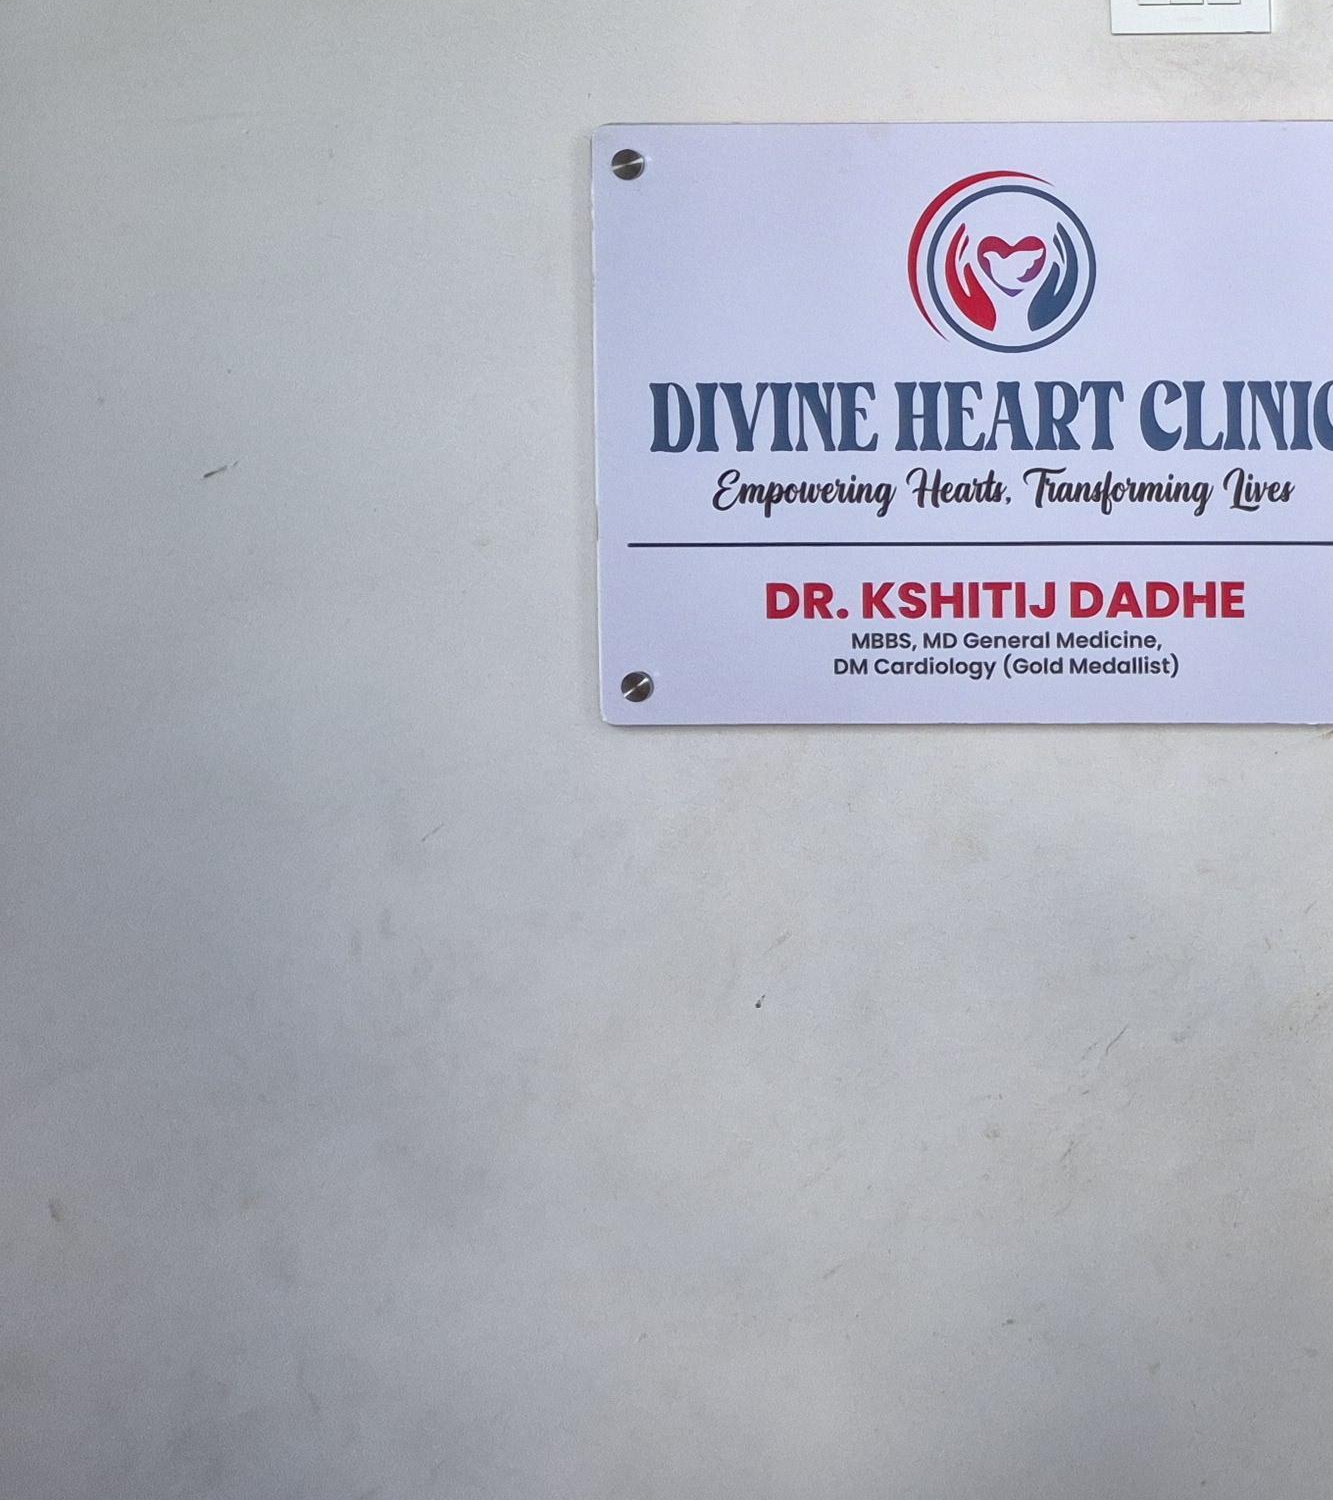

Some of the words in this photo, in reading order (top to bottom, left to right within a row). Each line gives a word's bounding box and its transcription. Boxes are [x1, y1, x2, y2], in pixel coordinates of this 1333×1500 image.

[649, 382, 878, 453] DIVINE
[895, 381, 1124, 451] HEART
[713, 469, 896, 518] Empowering
[906, 468, 1011, 508] Hearts,
[1023, 468, 1214, 516] Transforming
[1223, 468, 1295, 512] Lives
[767, 583, 848, 619] DR.
[863, 582, 1055, 619] KSHITIJ
[1070, 582, 1244, 618] DADHE
[852, 633, 916, 651] MBBS,
[923, 633, 957, 648] MD
[964, 632, 1050, 648] General
[1057, 631, 1161, 651] Medicine,
[834, 659, 867, 674] DM
[874, 657, 996, 680] Cardiology
[1004, 653, 1063, 678] (Gold
[1070, 653, 1178, 678] Medallist)
